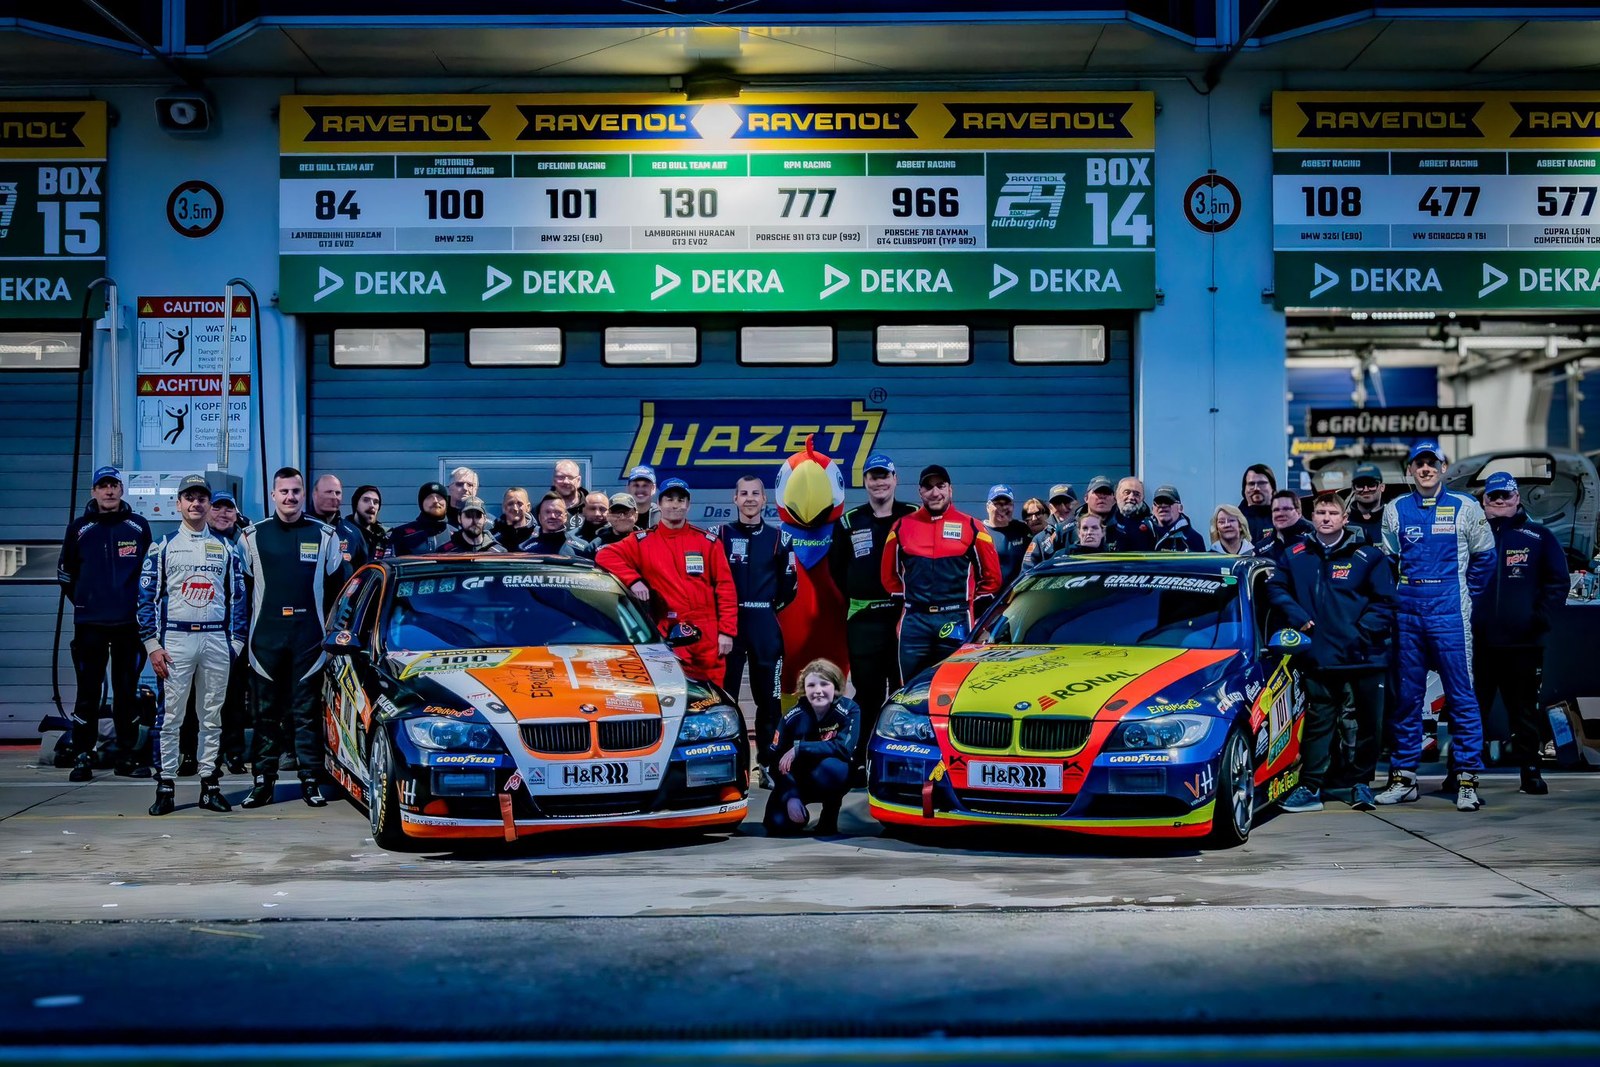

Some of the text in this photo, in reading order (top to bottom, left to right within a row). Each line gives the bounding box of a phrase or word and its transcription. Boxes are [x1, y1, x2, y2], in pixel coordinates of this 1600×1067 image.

[322, 115, 473, 132] RAVENOL
[535, 113, 688, 131] RAVENOL
[748, 113, 900, 131] RAVENOL
[962, 111, 1115, 130] RAVENOL
[1315, 111, 1467, 129] RAVENOL
[1529, 111, 1600, 129] RAV
[0, 122, 67, 138] NOL
[337, 163, 357, 172] TEAM
[434, 158, 474, 166] PISTORIUS
[537, 162, 606, 170] EIFELKIND RACING
[652, 161, 728, 170] RED BULL TEAM ABT
[784, 160, 832, 169] RPM RACING
[896, 160, 956, 169] ASBEST RACING
[1301, 159, 1361, 168] ASBEST RACING
[1418, 159, 1479, 168] ASBEST RACING
[1536, 159, 1596, 168] ASBEST RACING
[414, 167, 495, 175] BY EIFELKIND RACING
[1086, 158, 1151, 186] BOX
[38, 166, 102, 195] BOX
[316, 190, 361, 220] 84
[424, 190, 484, 220] 100
[546, 188, 597, 219] 101
[660, 188, 718, 218] 130
[778, 188, 837, 218] 777
[892, 187, 960, 218] 966
[994, 185, 1066, 217] 24
[1300, 186, 1362, 216] 108
[1418, 186, 1481, 216] 477
[1537, 186, 1598, 216] 577
[991, 217, 1056, 230] nürburgring
[1086, 192, 1152, 245] 14
[37, 201, 100, 254] 15
[644, 229, 736, 238] LAMBORGHINI HURACAN
[884, 228, 969, 237] PORSCHE 718 CAYMAN
[291, 231, 382, 239] LAMBORGHINI HURACAN
[541, 234, 603, 243] BMW 325I (E90)
[756, 232, 861, 242] PORSCHE 911 GT3 CUP (992)
[876, 236, 977, 246] GT4 CLUBSPORT (TYP 982)
[1300, 232, 1321, 240] BMW
[1341, 232, 1363, 242] (E90)
[1412, 232, 1487, 240] VW SCIROCCO R TSI
[1534, 234, 1584, 244] COMPETICIÓN
[672, 238, 687, 246] GT3
[354, 270, 446, 295] DEKRA
[524, 270, 616, 294] DEKRA
[692, 269, 784, 294] DEKRA
[860, 268, 954, 292] DEKRA
[1030, 268, 1122, 292] DEKRA
[1350, 268, 1442, 292] DEKRA
[163, 301, 224, 313] CAUTION
[205, 325, 237, 333] WATH
[195, 335, 247, 343] YOUR EAD
[195, 402, 247, 411] KOPFTOß
[200, 413, 241, 422] GEFHR
[1316, 411, 1467, 434] #GRÜNEKÖLLE
[651, 423, 856, 466] HAZET
[704, 506, 731, 518] Das
[502, 575, 544, 584] GRAN
[1104, 575, 1222, 590] GRAN TURISMO
[1171, 586, 1216, 594] SIMULATOR
[442, 654, 488, 665] 100
[1051, 670, 1139, 700] RONAL
[686, 744, 732, 756] GOODYEAR
[886, 744, 931, 755] GOODYEAR
[436, 754, 496, 765] GOODYEAR
[1110, 754, 1170, 764] GOODYEAR
[563, 766, 604, 785] H&R
[982, 764, 1021, 785] H&R
